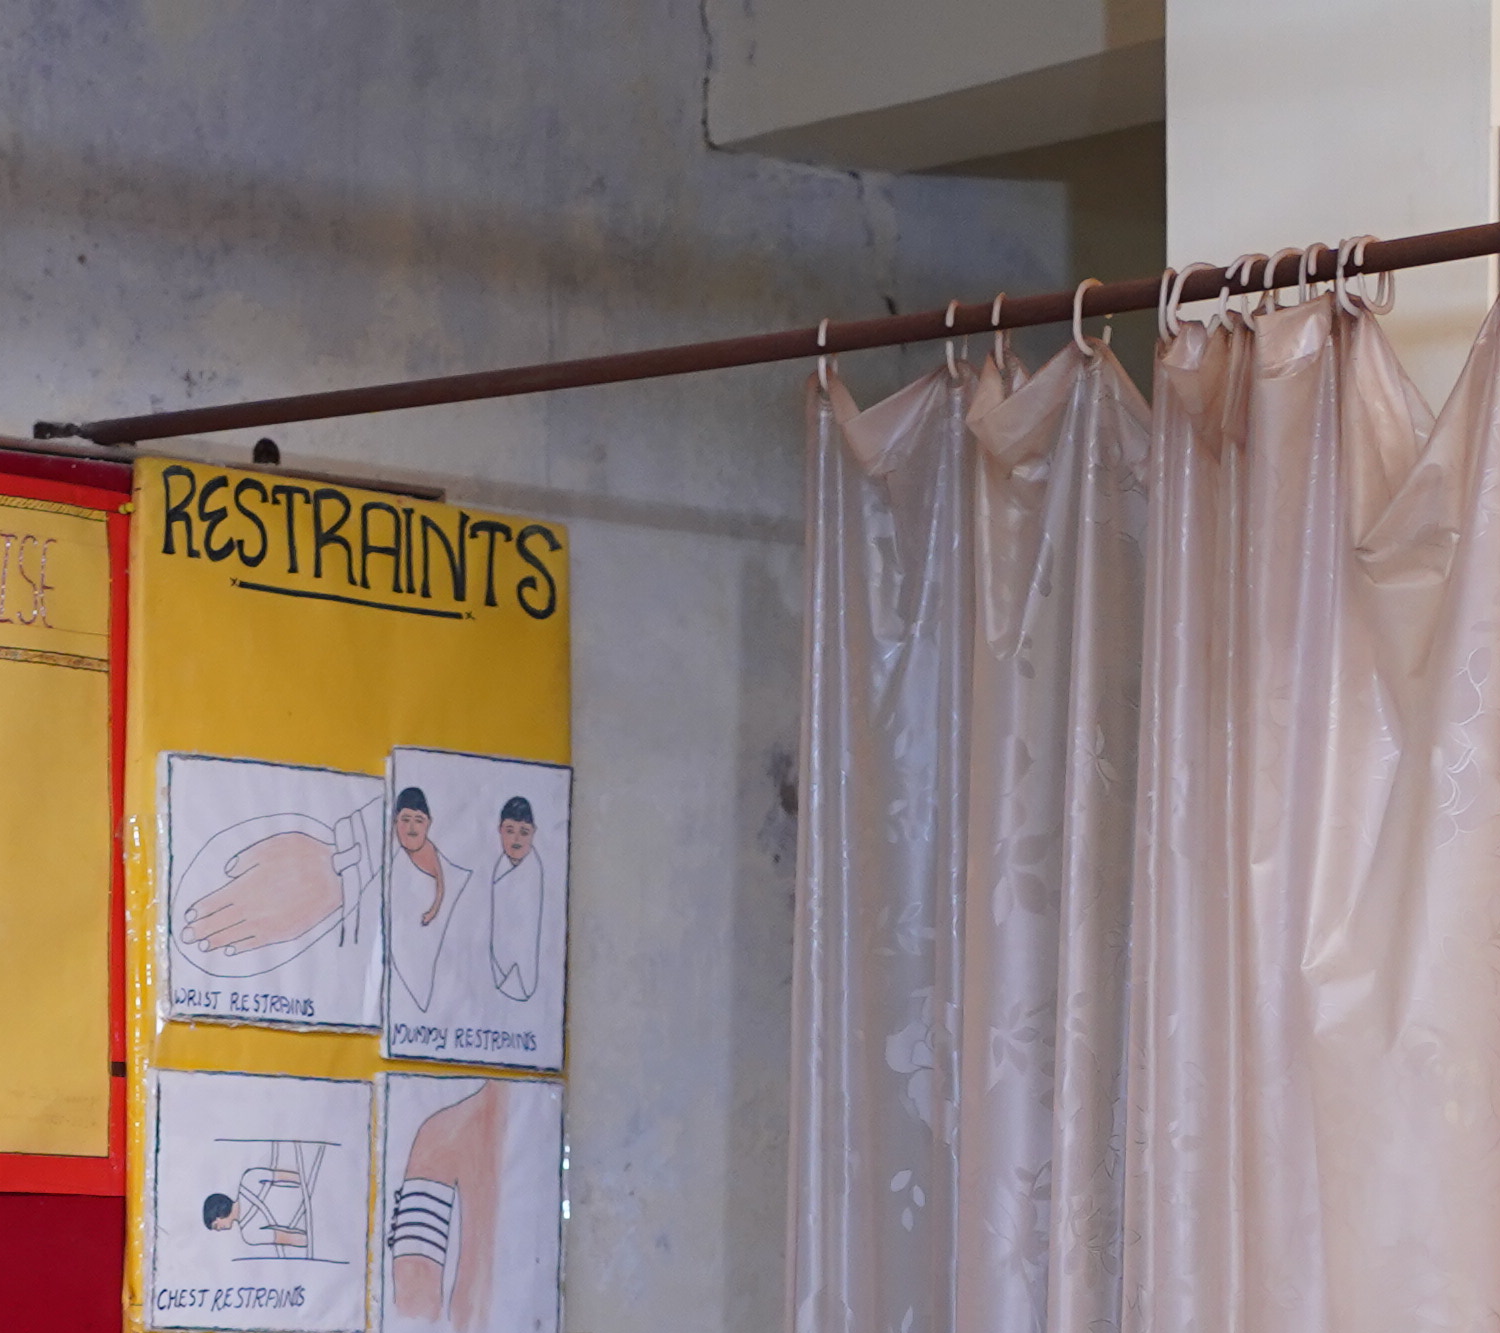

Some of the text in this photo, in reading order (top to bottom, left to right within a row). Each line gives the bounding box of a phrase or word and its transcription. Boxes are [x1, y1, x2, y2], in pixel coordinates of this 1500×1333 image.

[161, 464, 562, 620] RESTRAINTS
[173, 988, 222, 1010] WRIST
[156, 1288, 210, 1311] CHEST
